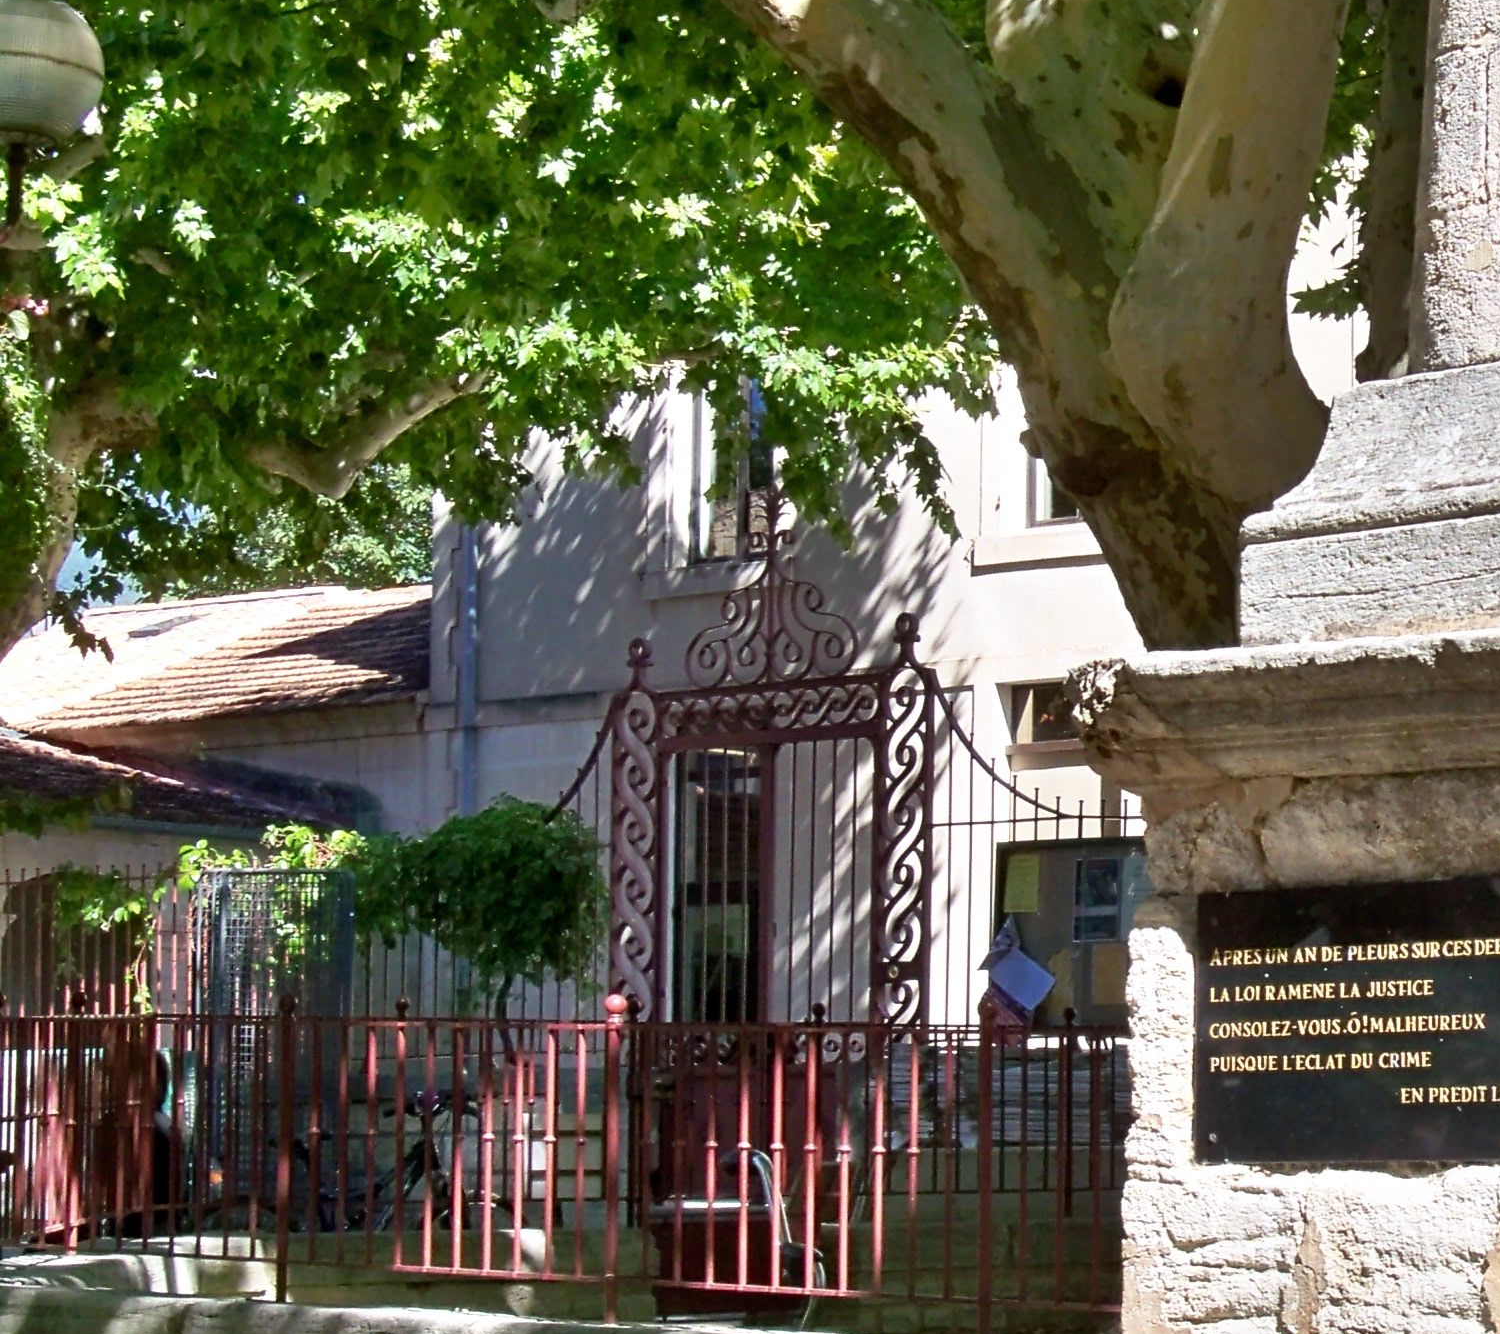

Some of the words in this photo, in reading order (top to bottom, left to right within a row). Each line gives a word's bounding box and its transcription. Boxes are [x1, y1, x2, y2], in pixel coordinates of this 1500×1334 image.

[1210, 947, 1262, 967] APRES
[1265, 948, 1289, 965] UN
[1293, 946, 1318, 964] AN
[1321, 945, 1344, 963] DE
[1347, 943, 1409, 962] PLEURS
[1411, 941, 1440, 959] SUR
[1442, 939, 1473, 958] CES
[1209, 987, 1231, 1003] LA
[1234, 985, 1261, 1002] LOI
[1265, 982, 1336, 1001] RAMENE
[1339, 982, 1361, 999] LA
[1366, 979, 1434, 998] JUSTICE
[1209, 1054, 1278, 1073] PUISQUE
[1283, 1052, 1346, 1071] L'ECLAT
[1350, 1051, 1373, 1069] DU
[1378, 1050, 1433, 1069] CRIME
[1400, 1087, 1424, 1104] EN
[1428, 1085, 1488, 1103] PREDIT
